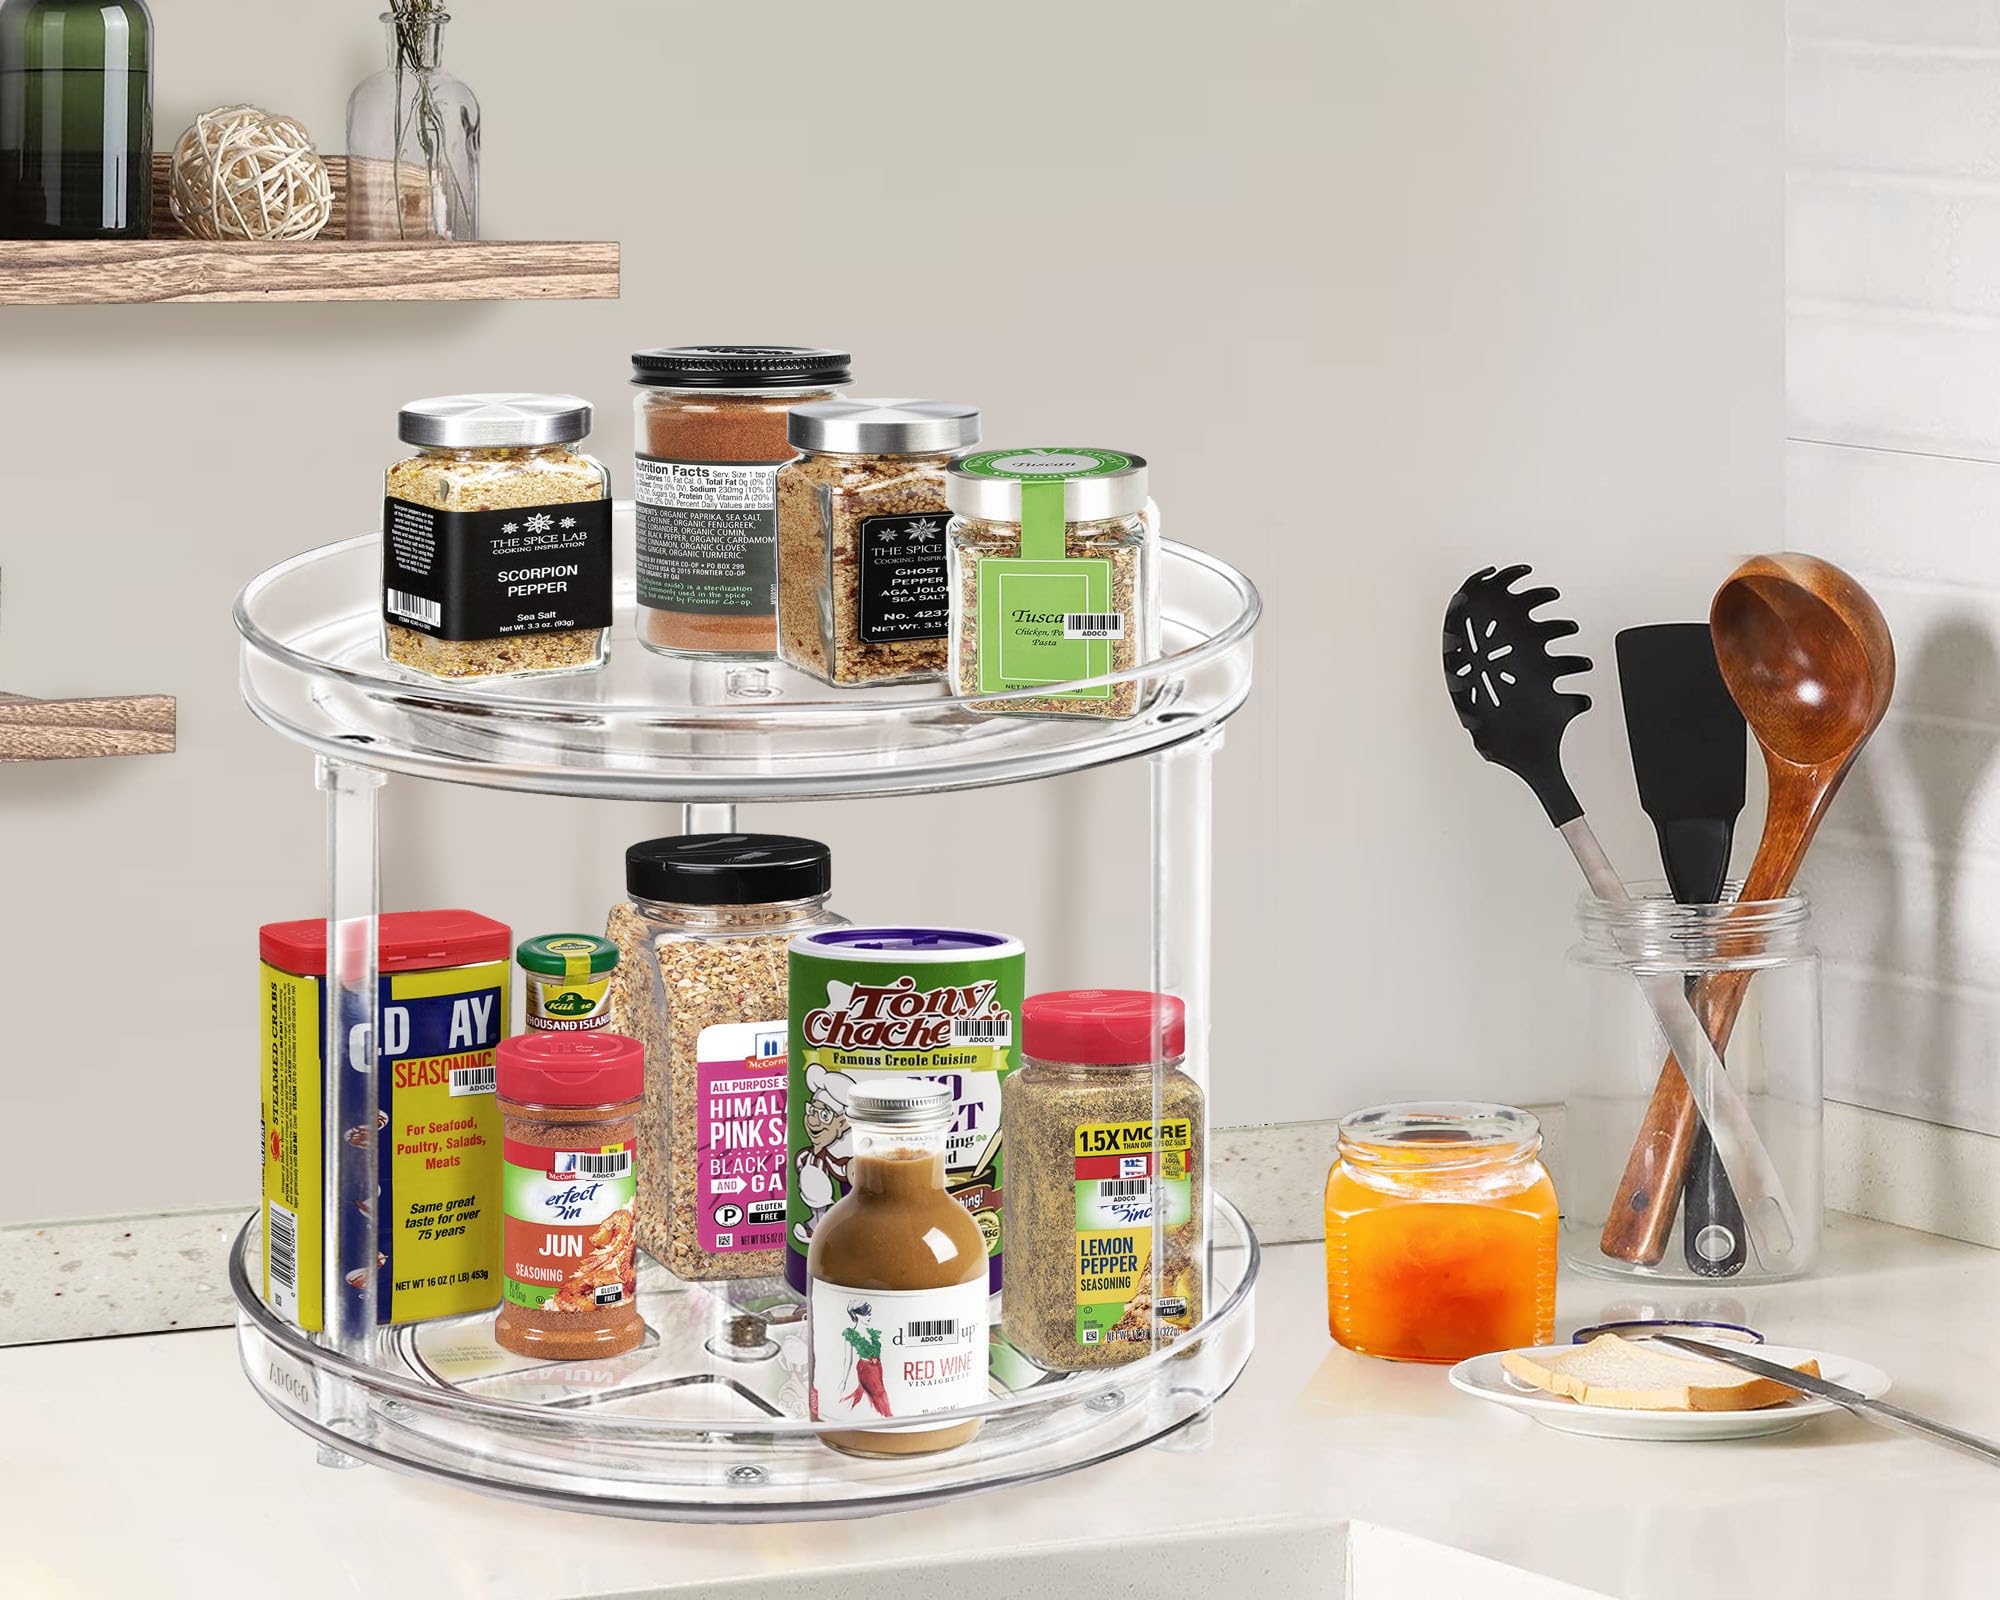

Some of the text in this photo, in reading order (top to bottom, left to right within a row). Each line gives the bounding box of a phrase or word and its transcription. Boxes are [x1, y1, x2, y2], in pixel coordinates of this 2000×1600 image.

[672, 466, 709, 477] Facts
[756, 471, 765, 479] tsp
[679, 492, 702, 500] Protein
[702, 501, 717, 509] Daily
[660, 510, 688, 519] ORGANIC
[690, 513, 723, 521] PAPRIKA,
[674, 519, 756, 529] ORGANIC FENUGREEK,
[648, 530, 662, 539] BLACK
[664, 533, 687, 542] PEPPER,
[690, 535, 724, 543] ORGANIC
[681, 527, 714, 536] ORGANIC
[717, 529, 746, 537] CUMIN,
[490, 532, 587, 548] THE SPICE LAB
[681, 542, 746, 552] ORGANIC CLOVES,
[493, 542, 584, 555] COOKING INSPIRATION
[669, 549, 700, 558] ORGANIC
[872, 544, 942, 556] THE SPICE
[874, 557, 914, 565] COOKING
[497, 564, 578, 582] SCORPION
[892, 577, 944, 586] PEPPER
[508, 582, 567, 597] PEPPER
[538, 611, 556, 619] Salt
[914, 609, 948, 618] 4237
[1016, 629, 1049, 637] Chicken,
[850, 977, 998, 1022] Tony
[527, 1015, 577, 1030] THOUSAND
[833, 1053, 977, 1066] Famous Creole Cuisine
[271, 1042, 279, 1125] STEAMED
[713, 1078, 779, 1092] ALL PURPOSE
[711, 1095, 787, 1118] HIMAL
[407, 1116, 477, 1136] For Seafood,
[711, 1119, 764, 1150] PINK
[1080, 1125, 1186, 1152] 1.5X MORE
[397, 1134, 485, 1155] Poultry, Salads,
[426, 1156, 460, 1170] Meats
[711, 1154, 785, 1175] BLACK P
[717, 1173, 783, 1192] AND GA
[410, 1196, 475, 1214] Same great
[756, 1202, 783, 1211] GLUTEN
[405, 1209, 480, 1228] taste for over
[725, 1209, 736, 1221] P
[761, 1213, 778, 1221] FREE
[418, 1225, 465, 1241] 75 years
[741, 1233, 777, 1245] NET WT OZ
[539, 1234, 582, 1257] JUN
[1081, 1237, 1133, 1256] LEMON
[515, 1263, 562, 1281] SEASONING
[1081, 1256, 1137, 1274] PEPPER
[396, 1269, 488, 1291] NET WT 16 OZ (1 LB) 453g
[1081, 1276, 1131, 1291] SEASONING
[605, 1294, 616, 1302] FREE
[904, 1350, 973, 1380] RED WINE
